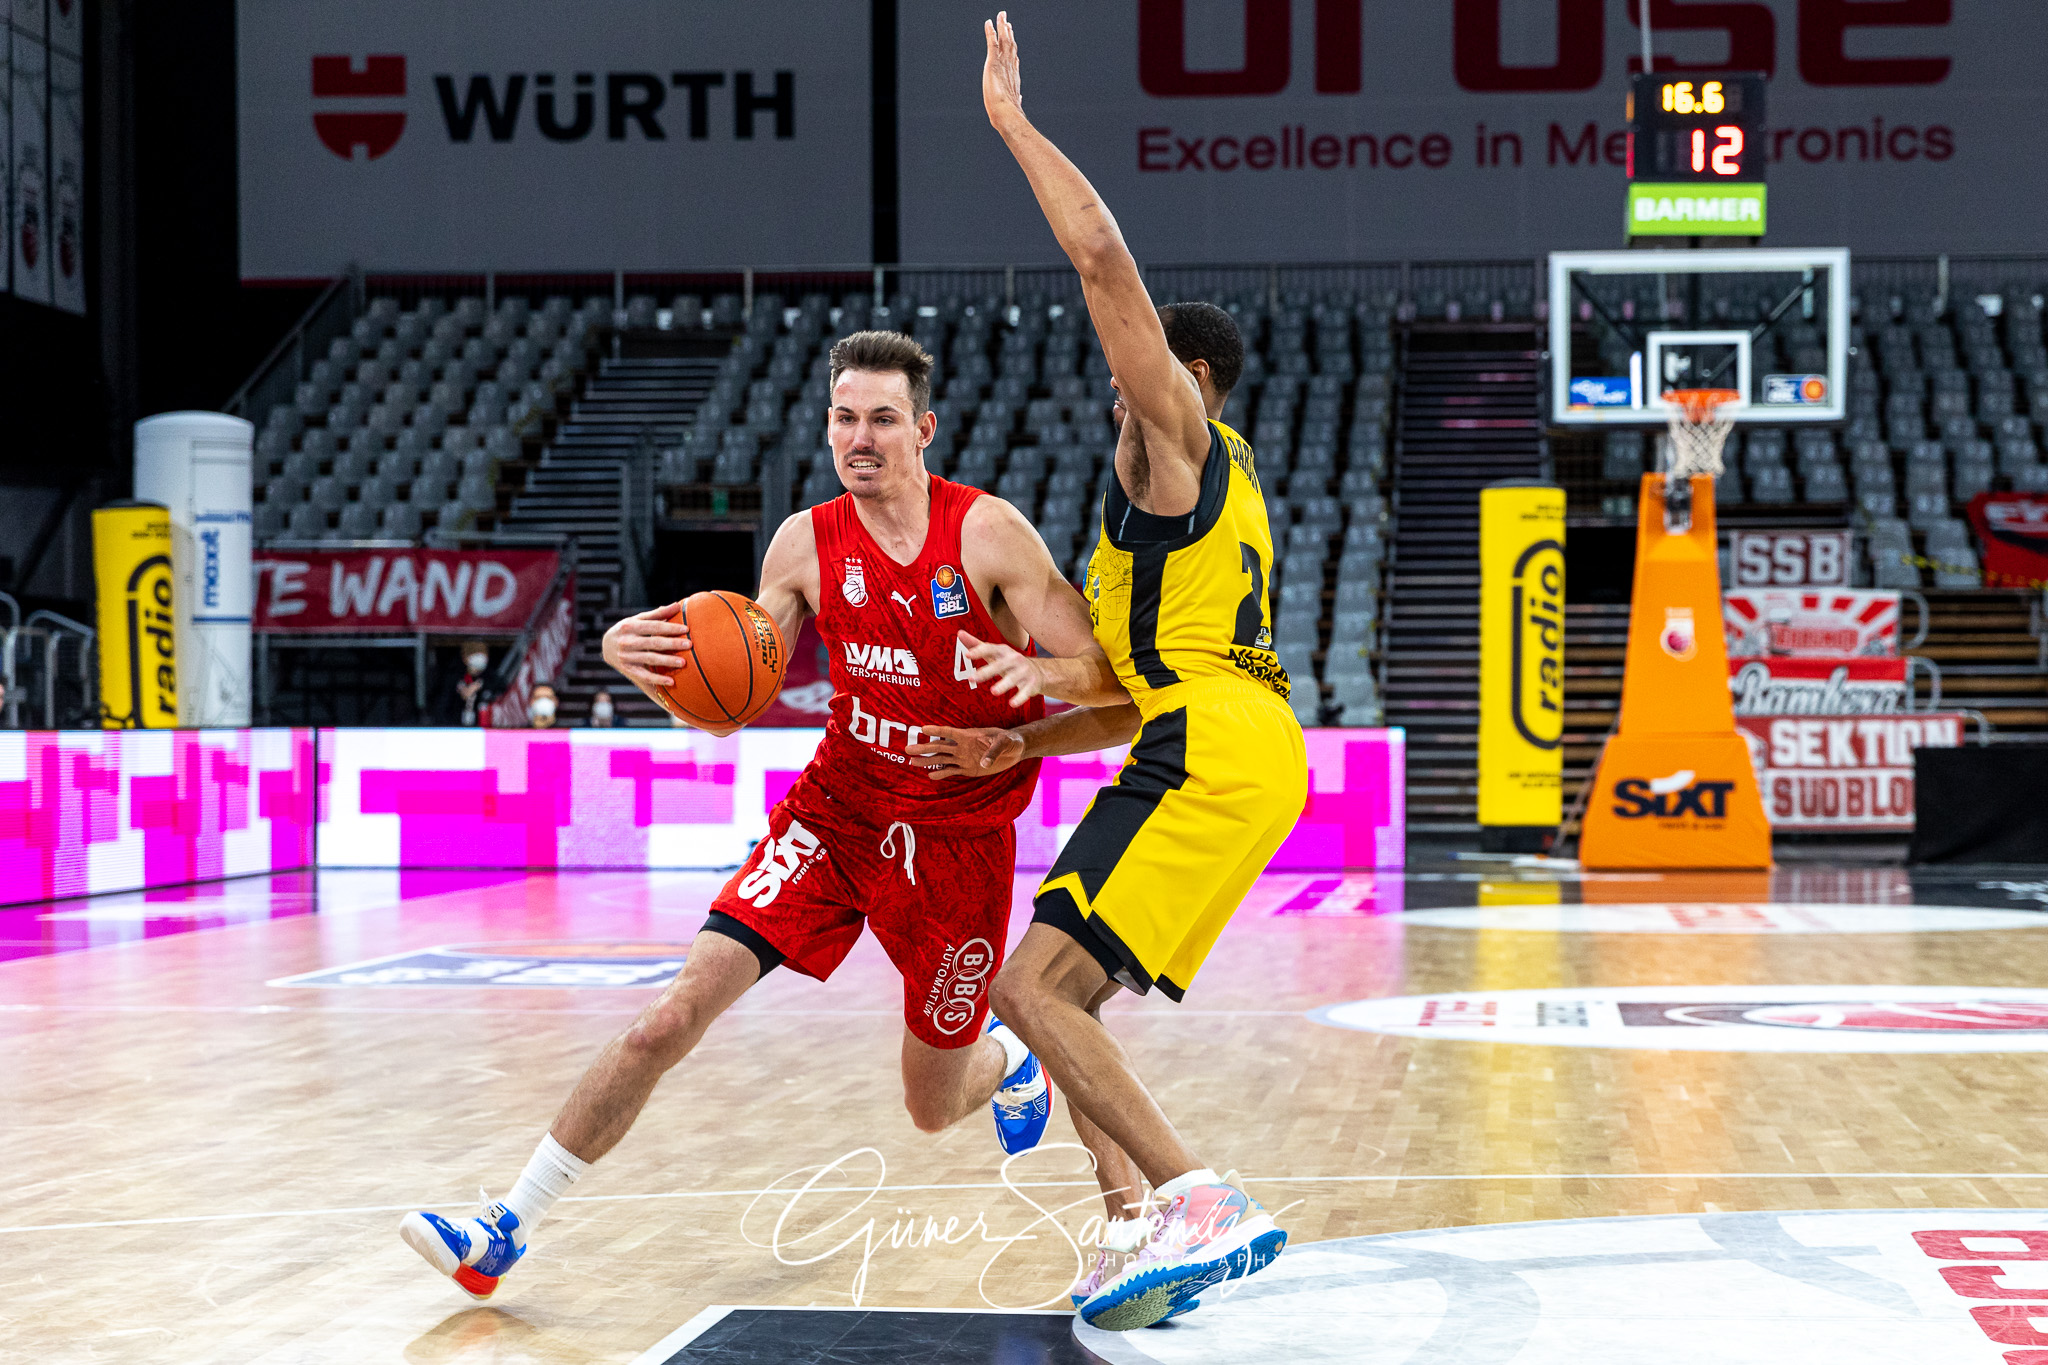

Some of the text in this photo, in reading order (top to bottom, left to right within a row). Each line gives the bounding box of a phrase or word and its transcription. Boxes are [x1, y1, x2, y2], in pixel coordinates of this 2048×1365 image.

[434, 70, 796, 143] WÜRTH
[1662, 81, 1725, 114] 16.6
[1137, 115, 1955, 172] Excellence in Meronics
[1691, 125, 1744, 175] 12
[1634, 197, 1761, 222] BARMER
[1740, 536, 1843, 584] SSB
[251, 556, 517, 622] TE WAND
[938, 602, 965, 615] BBL
[145, 578, 176, 715] radio
[1531, 564, 1560, 712] radio
[848, 696, 941, 757] bro
[1613, 771, 1735, 818] SIXT
[816, 848, 827, 860] ca
